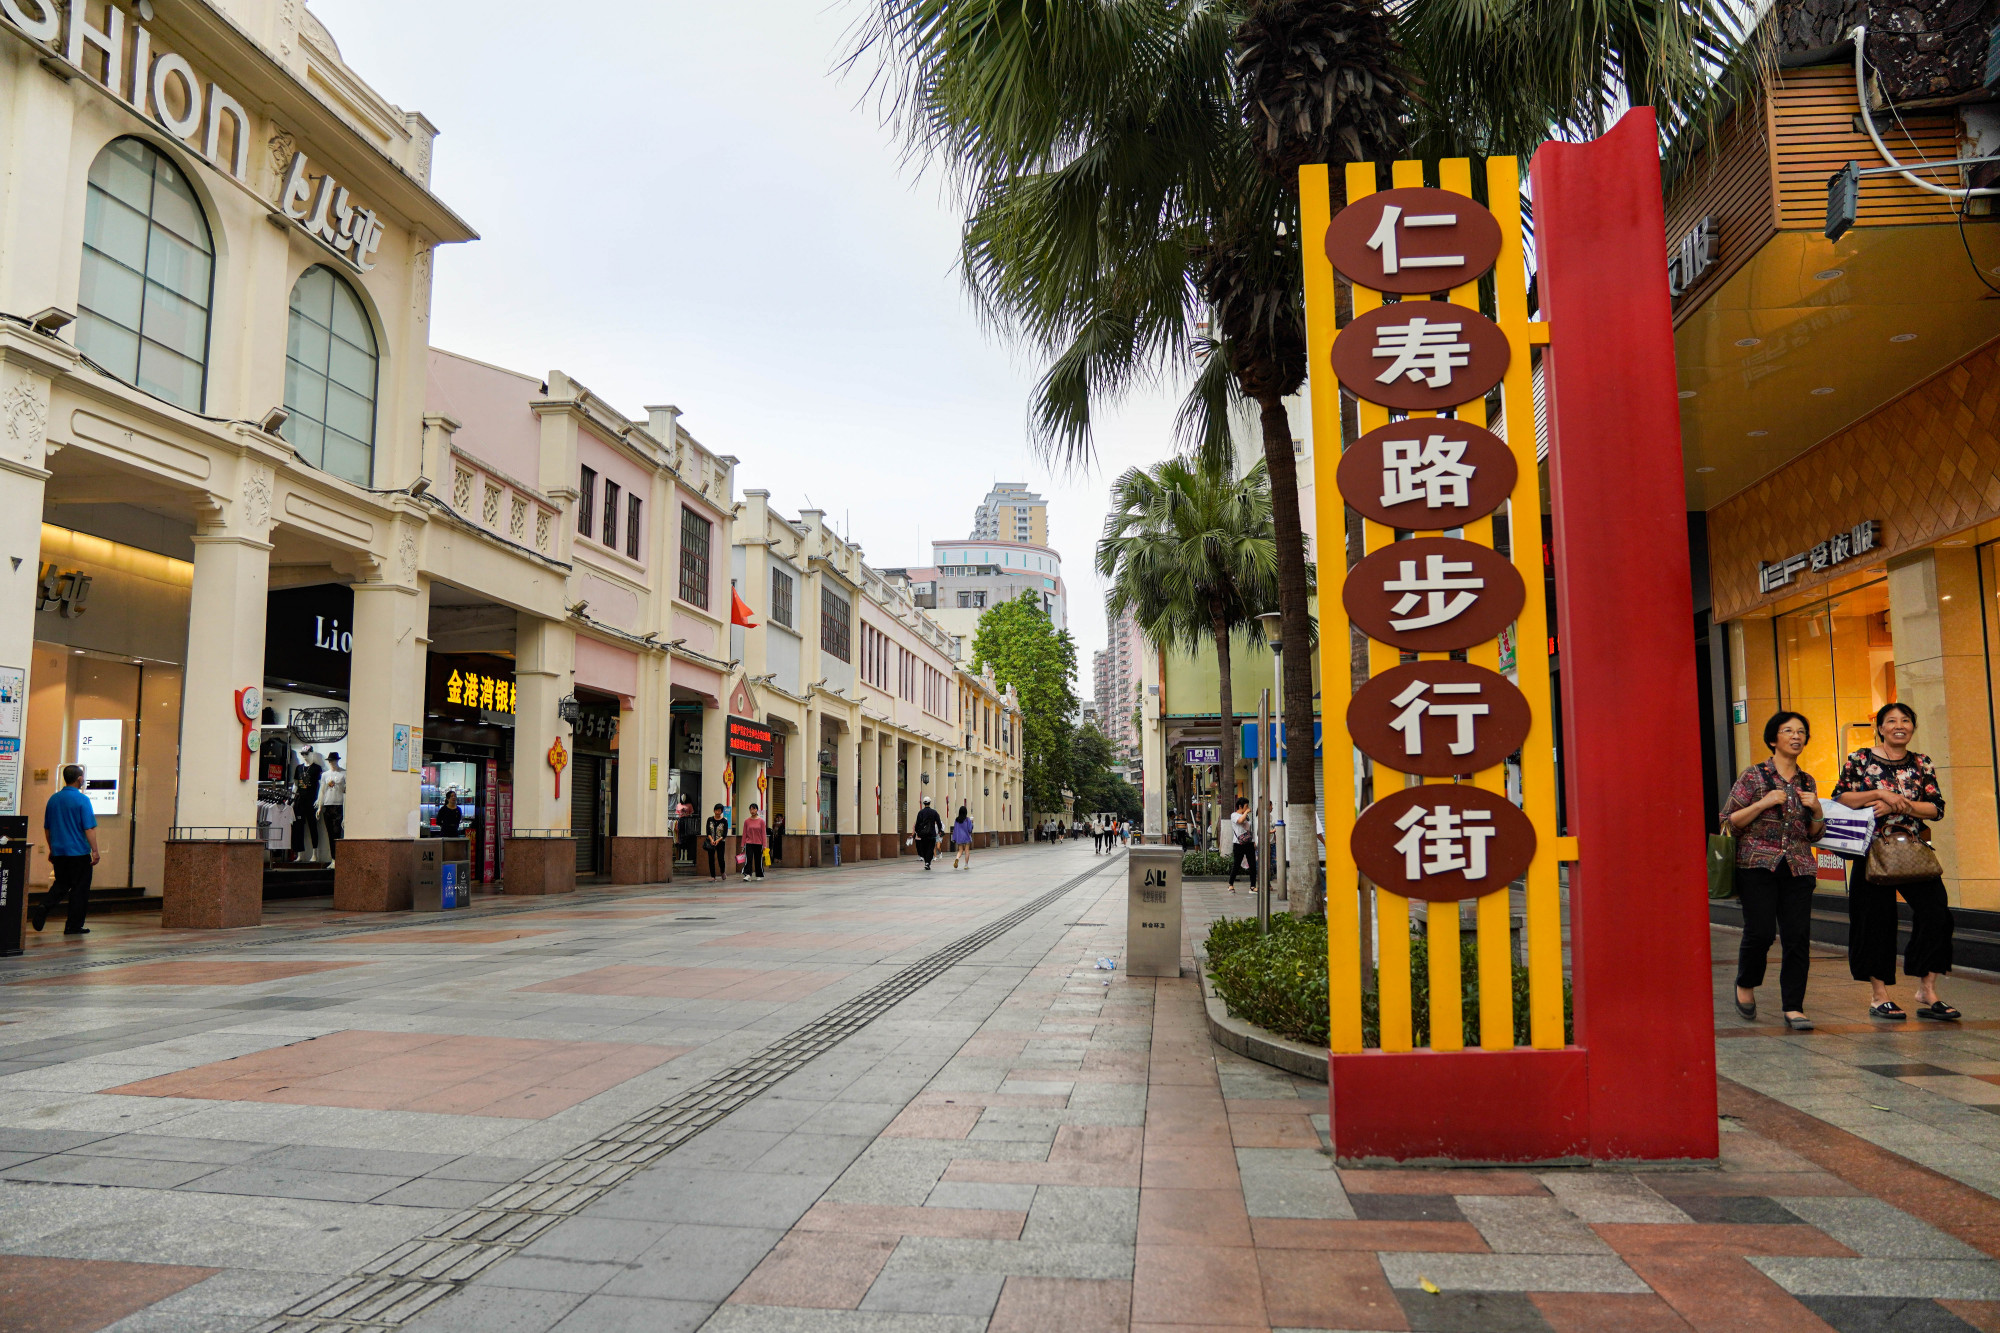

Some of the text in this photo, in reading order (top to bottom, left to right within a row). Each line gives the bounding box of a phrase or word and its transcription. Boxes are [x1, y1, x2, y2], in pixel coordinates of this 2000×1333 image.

[1366, 205, 1496, 881] 仁寿路步行街
[1810, 520, 1874, 573] 爱依服
[315, 615, 353, 653] Lio
[82, 736, 93, 745] 2F
